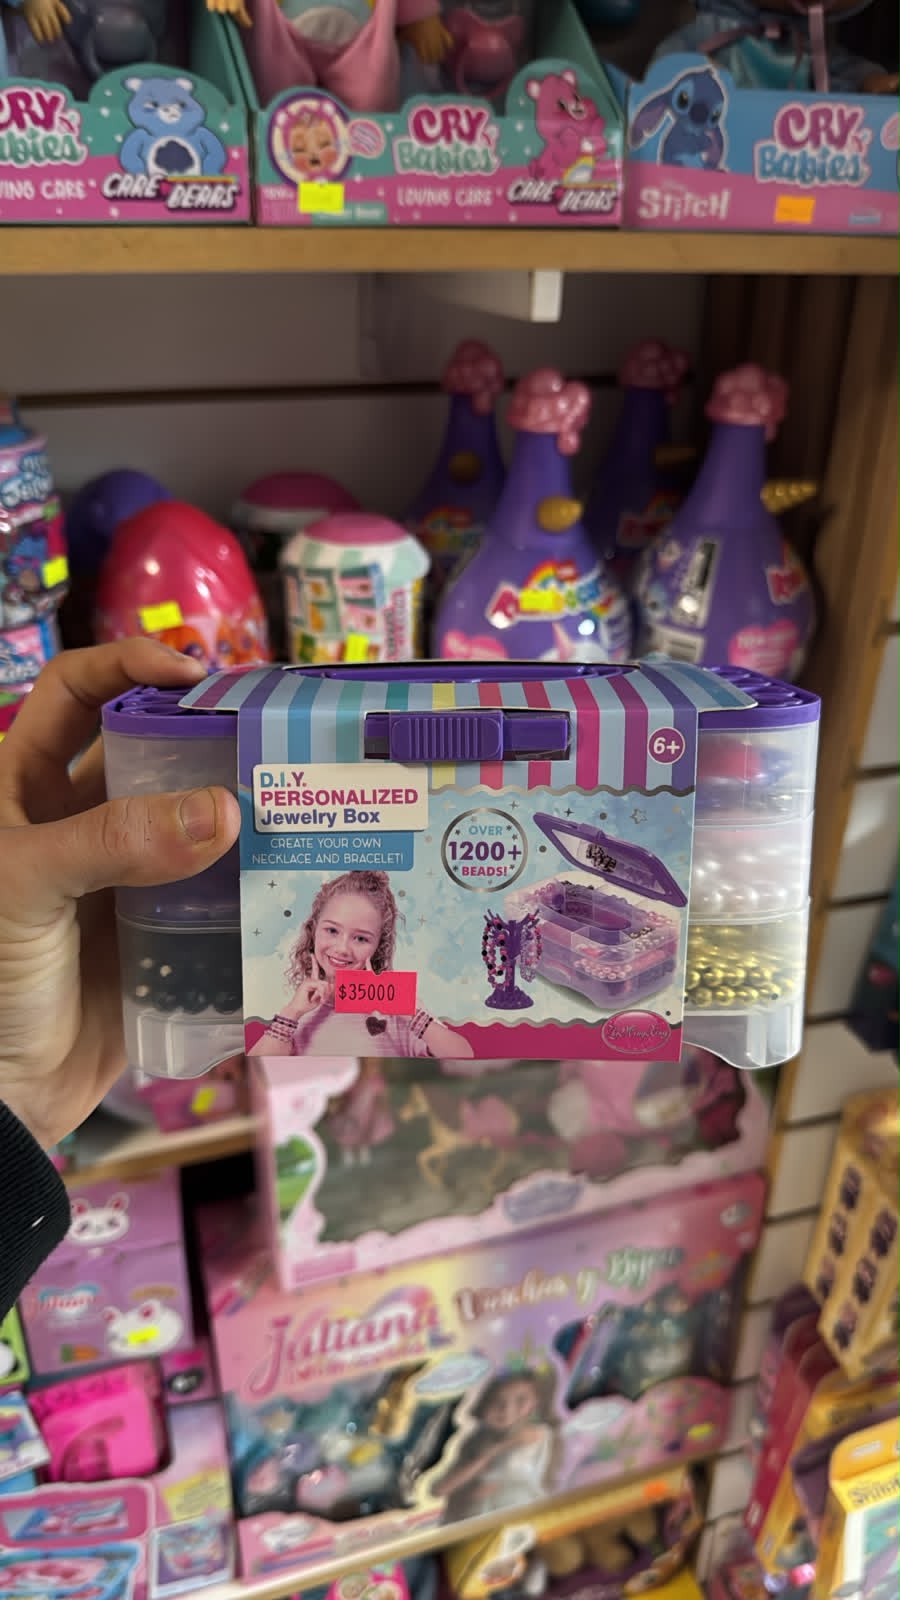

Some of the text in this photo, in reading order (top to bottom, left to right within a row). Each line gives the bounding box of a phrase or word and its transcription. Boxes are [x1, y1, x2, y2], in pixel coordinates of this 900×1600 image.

[0, 91, 61, 131] RY
[412, 106, 486, 145] CRY
[779, 107, 860, 150] CRY
[0, 129, 86, 165] bies
[397, 140, 496, 175] Babies
[758, 144, 868, 185] Babies
[102, 172, 164, 198] CARE
[167, 184, 239, 209] BEARS
[507, 179, 617, 212] CARE BEARS
[653, 736, 681, 755] 6+
[260, 771, 308, 788] D.I.Y.
[261, 788, 419, 807] PERSONALIZED
[260, 808, 381, 828] Jewelry Box
[468, 824, 504, 836] OVER
[270, 837, 382, 849] CREATE YOUR OWN
[448, 840, 522, 862] 1200+
[251, 851, 404, 865] NECKLACE AND BRACELET!
[461, 865, 508, 877] BEADS!
[338, 983, 396, 1001] $35000
[247, 1306, 438, 1396] Juliana
